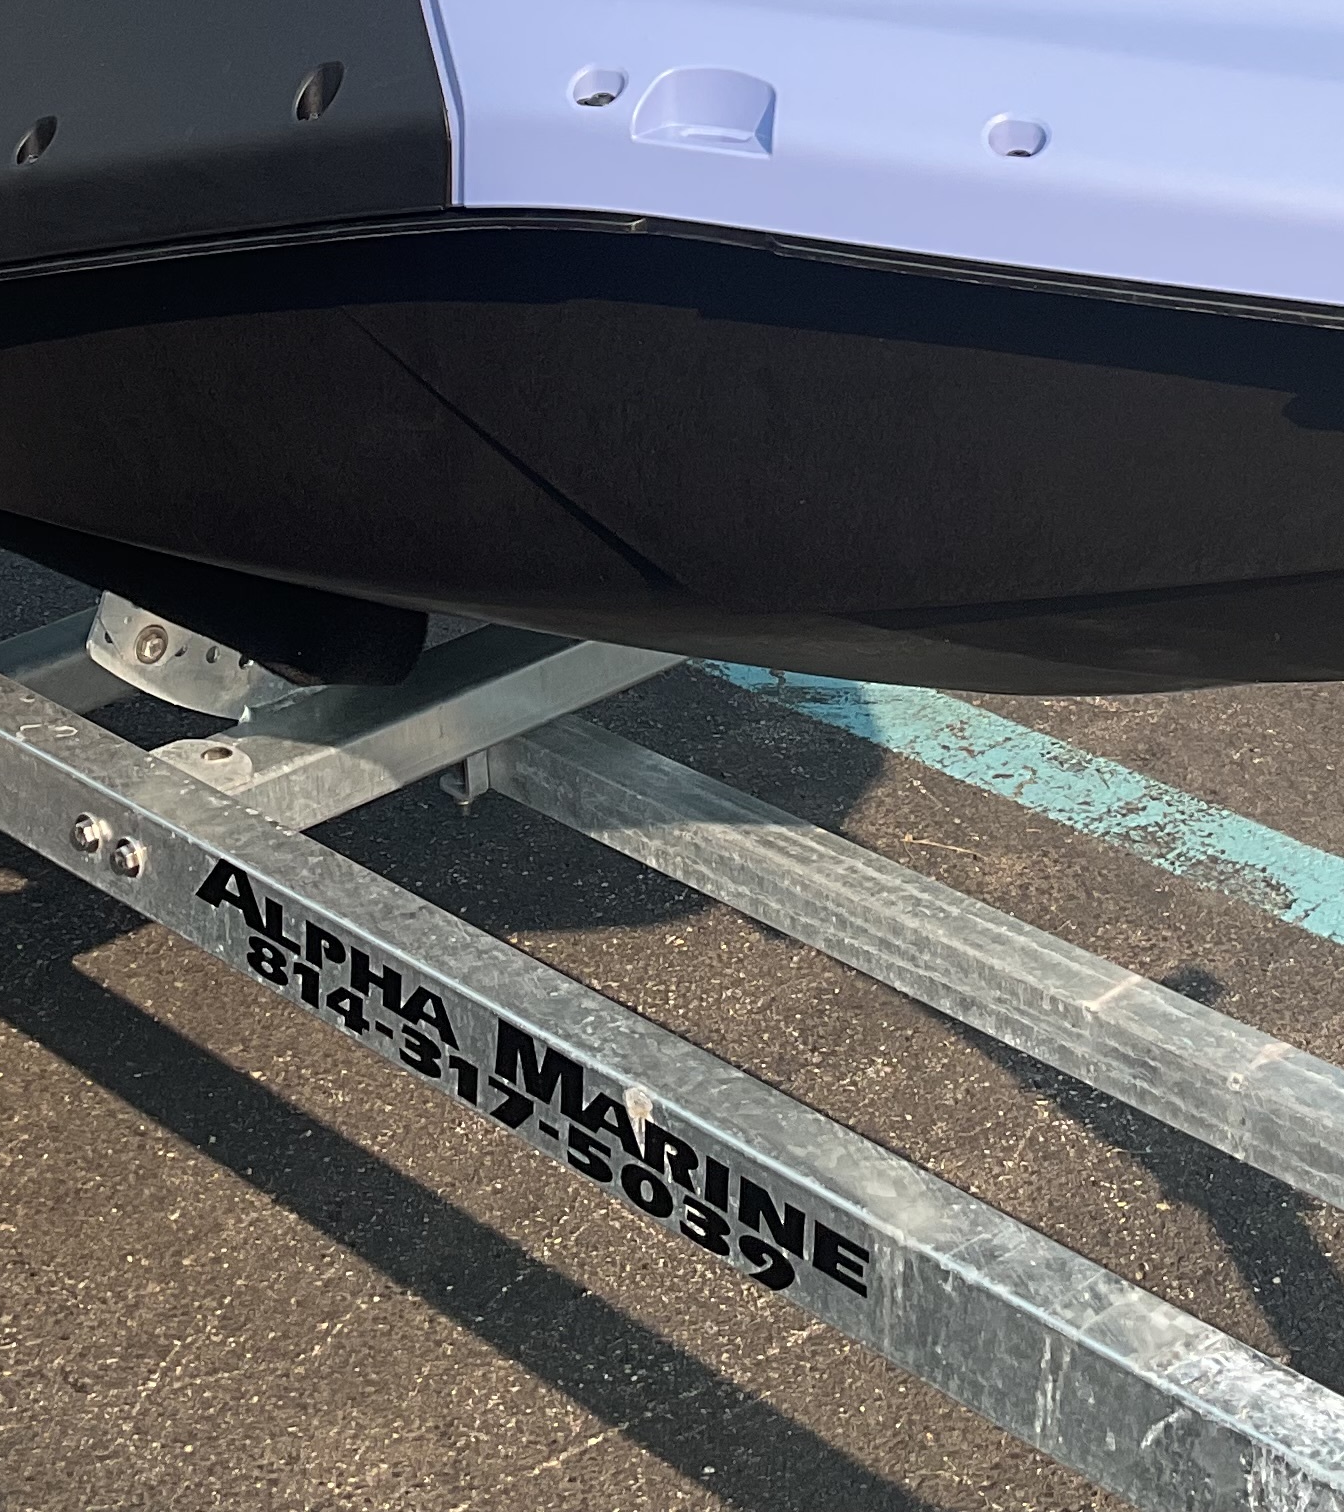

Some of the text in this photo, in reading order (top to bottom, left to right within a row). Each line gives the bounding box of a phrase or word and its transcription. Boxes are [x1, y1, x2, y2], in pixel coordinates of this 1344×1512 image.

[196, 857, 870, 1299] ALPHA MARINE
[246, 933, 796, 1293] 814-317-5039
